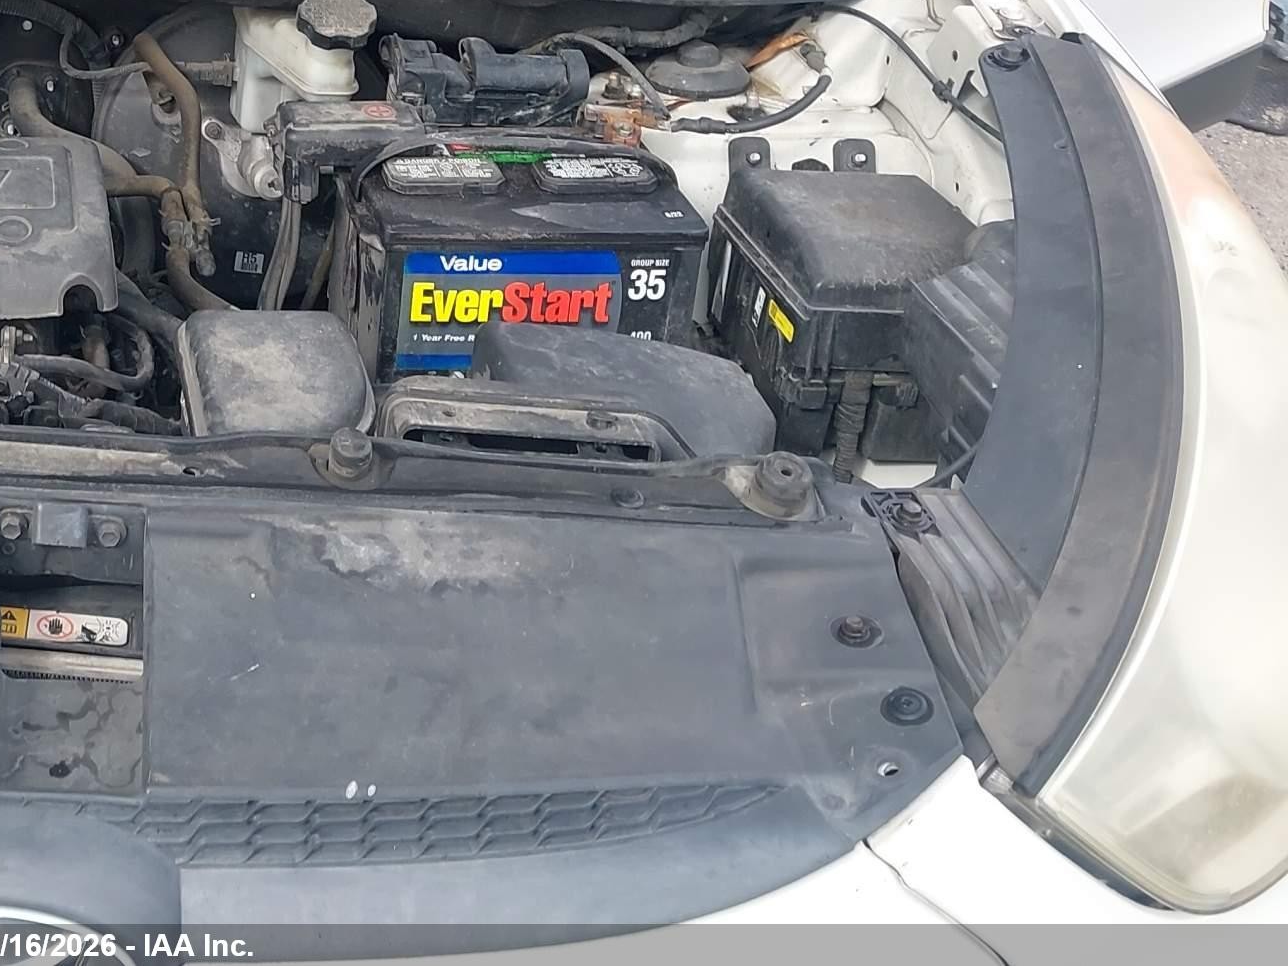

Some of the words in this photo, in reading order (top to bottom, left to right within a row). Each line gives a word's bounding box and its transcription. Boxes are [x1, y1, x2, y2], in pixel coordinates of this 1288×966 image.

[440, 255, 503, 272] Value
[630, 259, 655, 267] GROUP
[655, 259, 670, 267] SIZE
[627, 269, 667, 301] 35
[410, 281, 612, 324] EverStart
[422, 333, 442, 342] Year
[444, 333, 466, 342] Free
